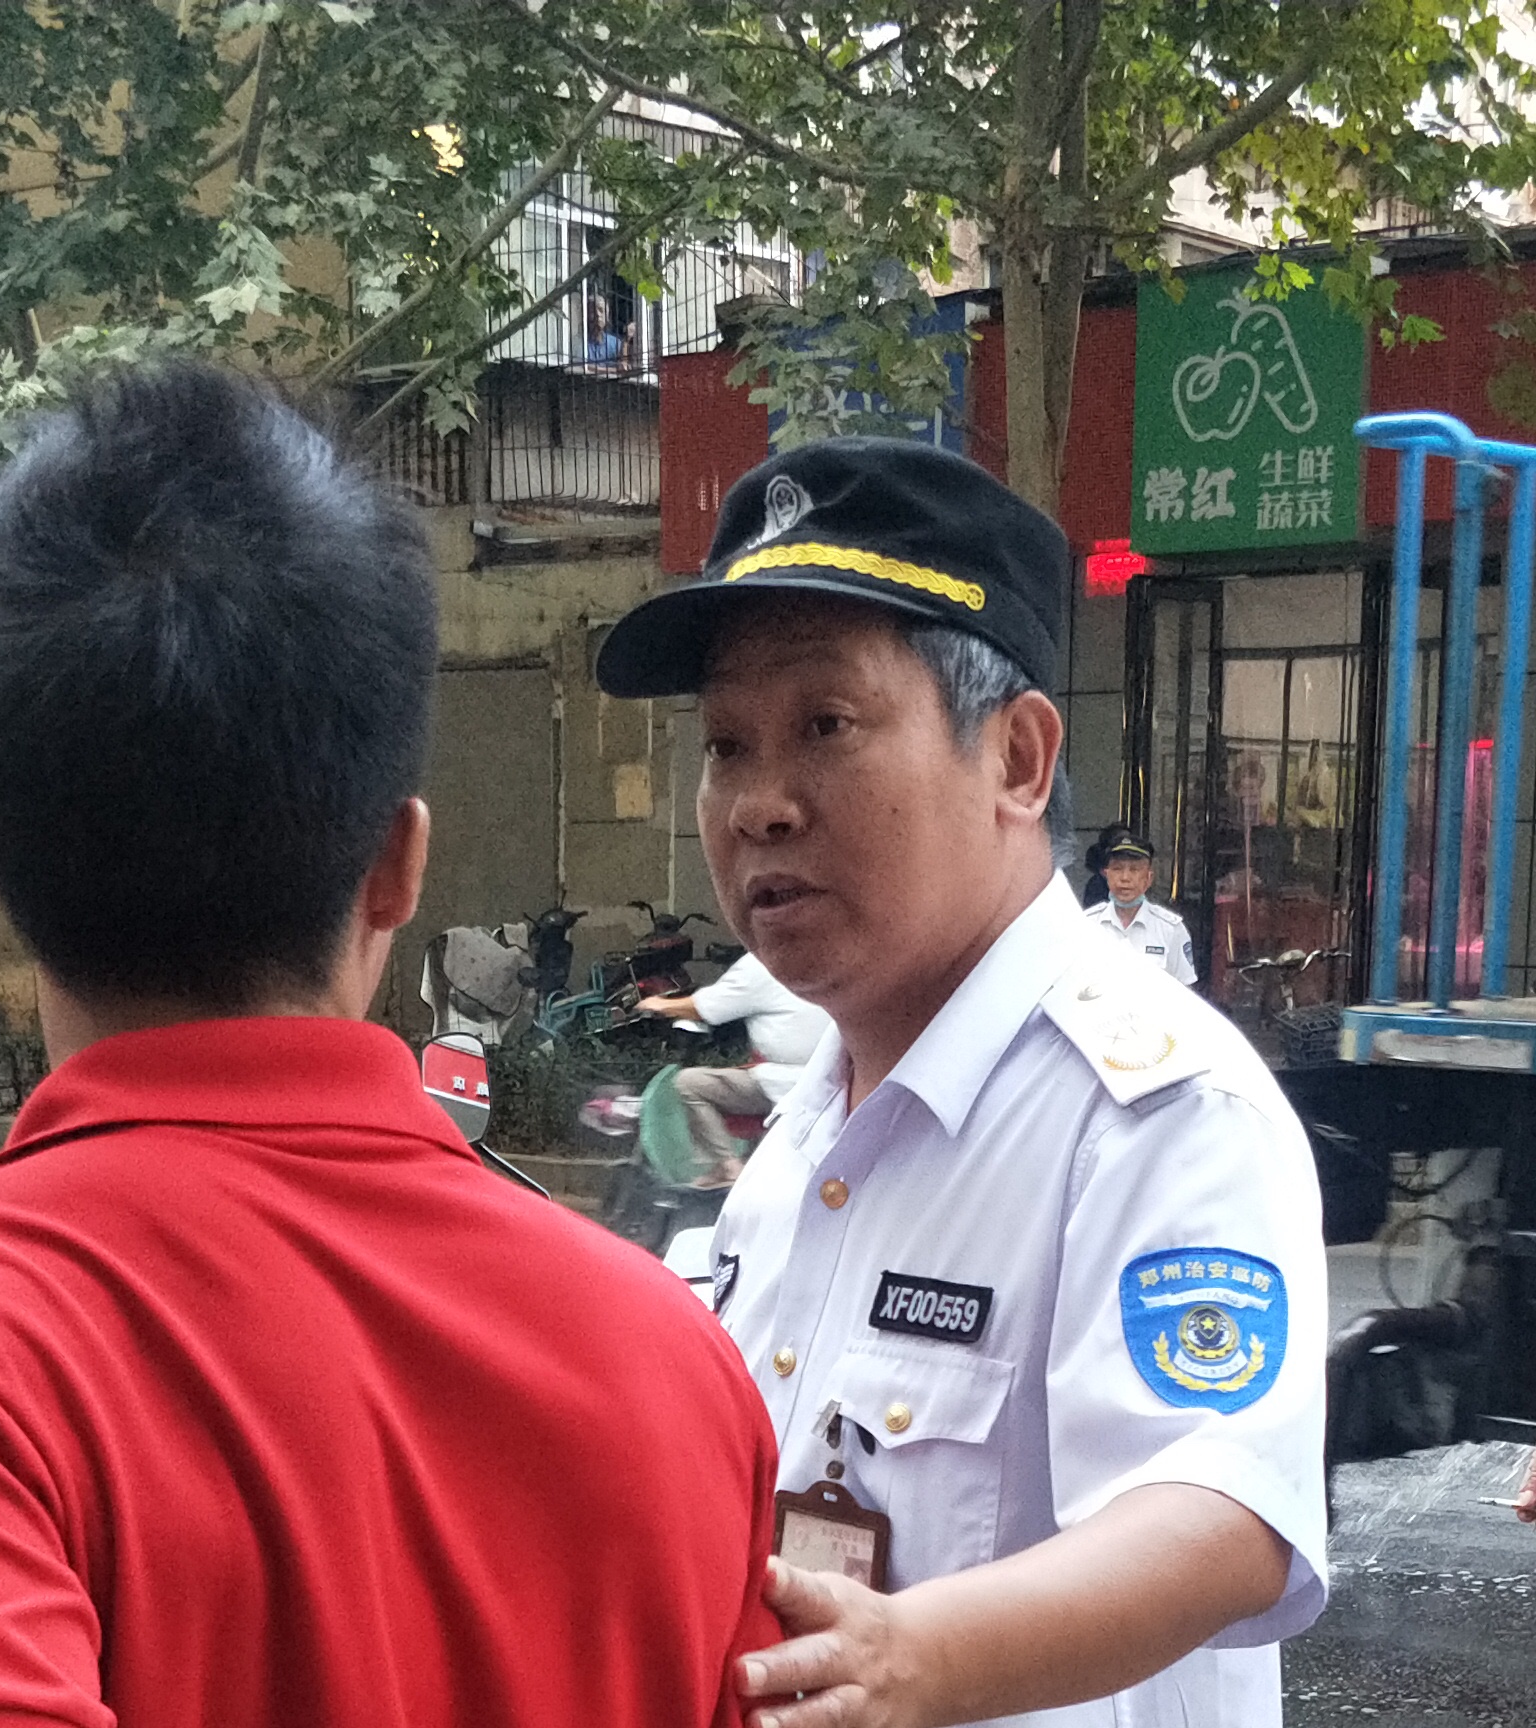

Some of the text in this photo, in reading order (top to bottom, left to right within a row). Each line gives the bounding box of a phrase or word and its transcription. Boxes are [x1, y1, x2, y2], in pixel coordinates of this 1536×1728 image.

[1259, 445, 1334, 487] 生鲜
[1143, 466, 1237, 522] 常红
[1256, 488, 1333, 531] 蔬菜
[1137, 1261, 1272, 1293] 郑州治安巡防
[878, 1284, 980, 1333] XF00559
